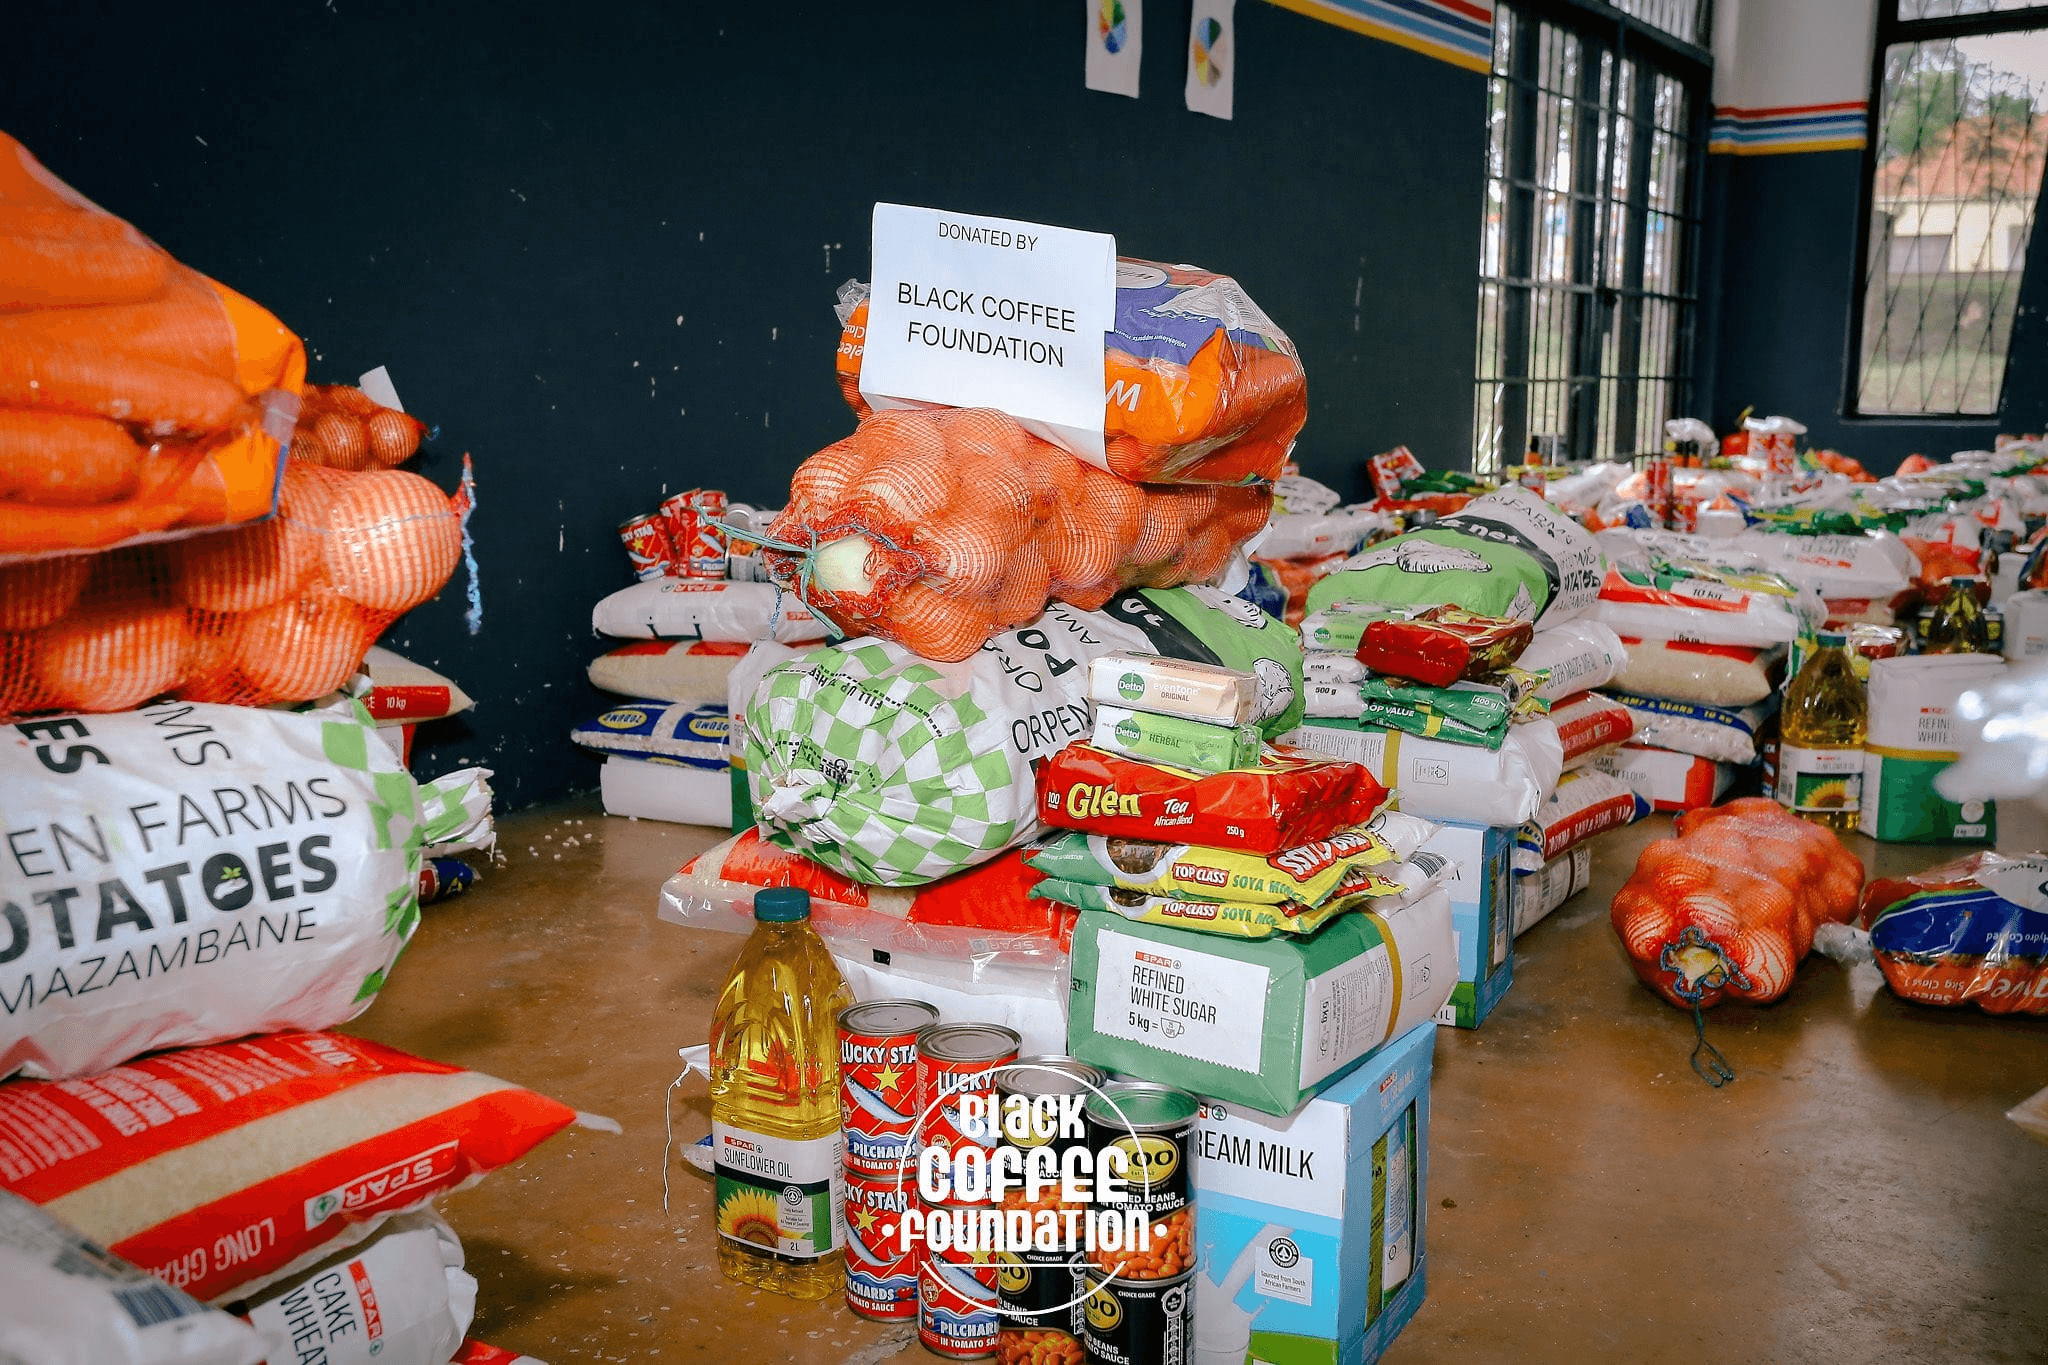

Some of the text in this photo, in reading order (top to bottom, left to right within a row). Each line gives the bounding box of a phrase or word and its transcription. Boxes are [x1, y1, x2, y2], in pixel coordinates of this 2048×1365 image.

[938, 222, 1038, 251] DONATED BY
[898, 282, 1076, 332] BLACK COFFEE
[907, 321, 1064, 368] FOUNDATION
[1118, 680, 1144, 691] Dettol
[1160, 691, 1190, 702] ORIGINAL
[1386, 706, 1415, 717] VALUE
[1011, 696, 1093, 754] ORPEN
[1115, 726, 1141, 740] Dettol
[1149, 733, 1181, 748] HERBAL
[1048, 791, 1061, 805] 100
[1164, 799, 1190, 815] Tea
[6, 778, 348, 878] EN FARMS
[1154, 815, 1178, 827] African
[1226, 825, 1245, 838] 250 g
[1174, 865, 1197, 880] TOP
[1196, 869, 1226, 885] CLASS
[1232, 874, 1264, 892] SOYA
[1165, 902, 1252, 922] TOP CLASS SOYA
[1142, 953, 1172, 968] SPAR
[1132, 964, 1185, 995] REFINED
[1130, 986, 1217, 1025] WHITE SUGAR
[1128, 1010, 1136, 1026] 5
[1137, 1012, 1150, 1033] kg
[841, 1039, 886, 1064] LUCKY
[937, 1070, 996, 1097] LUCKY
[730, 1138, 755, 1152] SPAR
[724, 1147, 793, 1179] SUNFLOWER OIL
[862, 1159, 894, 1170] TOMATO
[1258, 1140, 1314, 1181] MILK
[345, 1157, 434, 1207] SPAR
[867, 1190, 909, 1213] STAR
[1156, 1198, 1185, 1211] SAUCE
[213, 1217, 276, 1272] LONG
[1026, 1254, 1063, 1263] CHOICE GRADE
[1117, 1290, 1156, 1299] CHOICE GRADE
[312, 1272, 357, 1344] CAKE
[357, 1275, 384, 1341] SPAR
[871, 1301, 895, 1312] SAUCE
[940, 1337, 949, 1346] IN
[950, 1338, 984, 1349] TOMATO
[1093, 1336, 1119, 1355] BEANS
[1100, 1352, 1130, 1365] SAUCE
